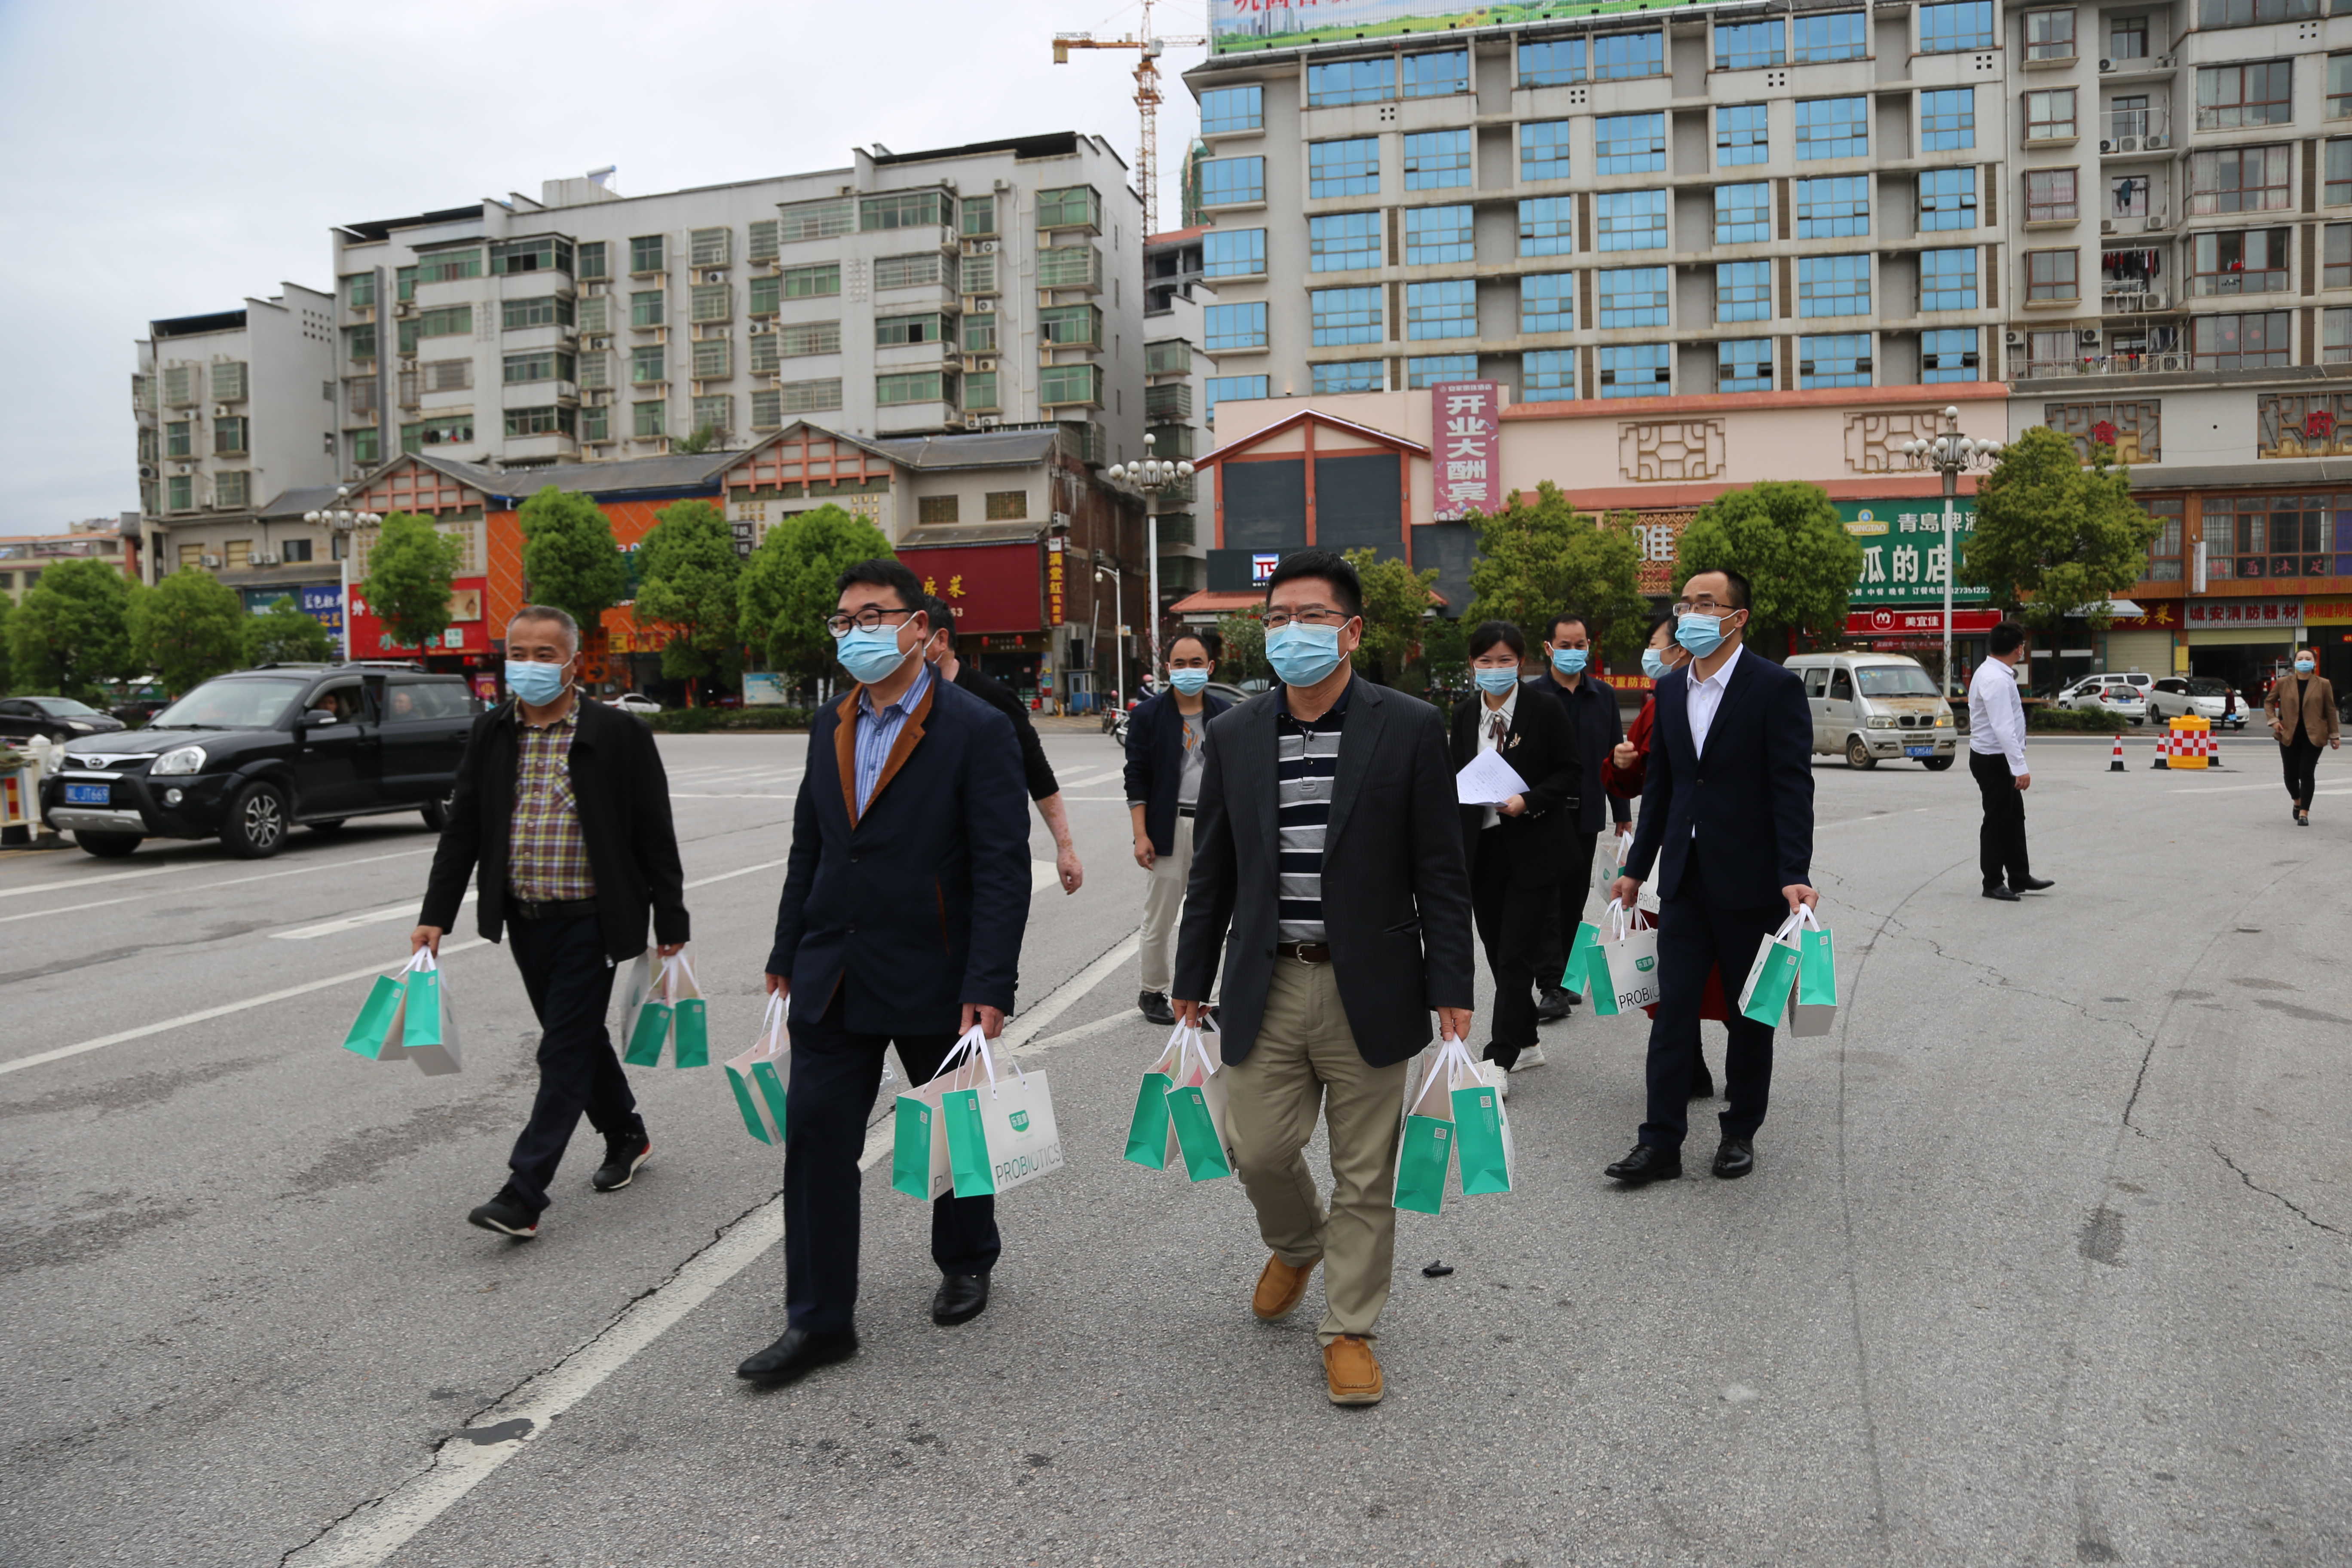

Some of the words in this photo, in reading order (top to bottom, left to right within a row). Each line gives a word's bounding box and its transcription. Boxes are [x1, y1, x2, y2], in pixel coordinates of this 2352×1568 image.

[2305, 410, 2334, 438] 府
[1446, 395, 1488, 502] 开业大酬宾
[1847, 524, 1887, 533] TSINGTAO
[1868, 588, 1883, 596] 中餐
[1905, 616, 1939, 627] 美宜佳
[995, 1143, 1061, 1185] PROBIOTICS
